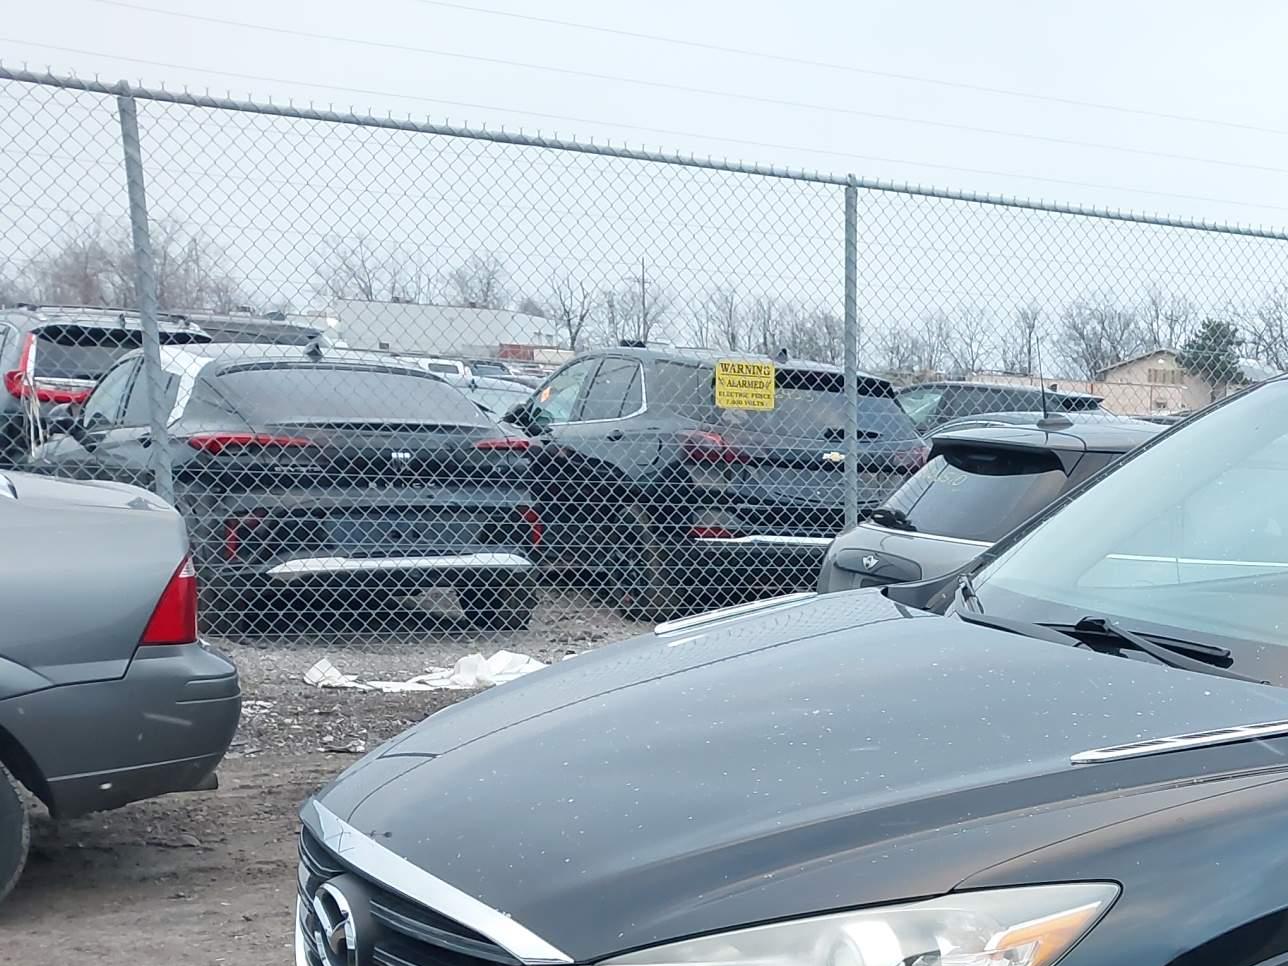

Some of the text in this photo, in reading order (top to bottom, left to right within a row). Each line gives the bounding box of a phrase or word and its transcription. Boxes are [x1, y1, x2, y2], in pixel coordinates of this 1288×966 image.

[720, 362, 770, 376] WARNING
[727, 379, 765, 390] ALARMED
[718, 391, 748, 399] ELECTRIC
